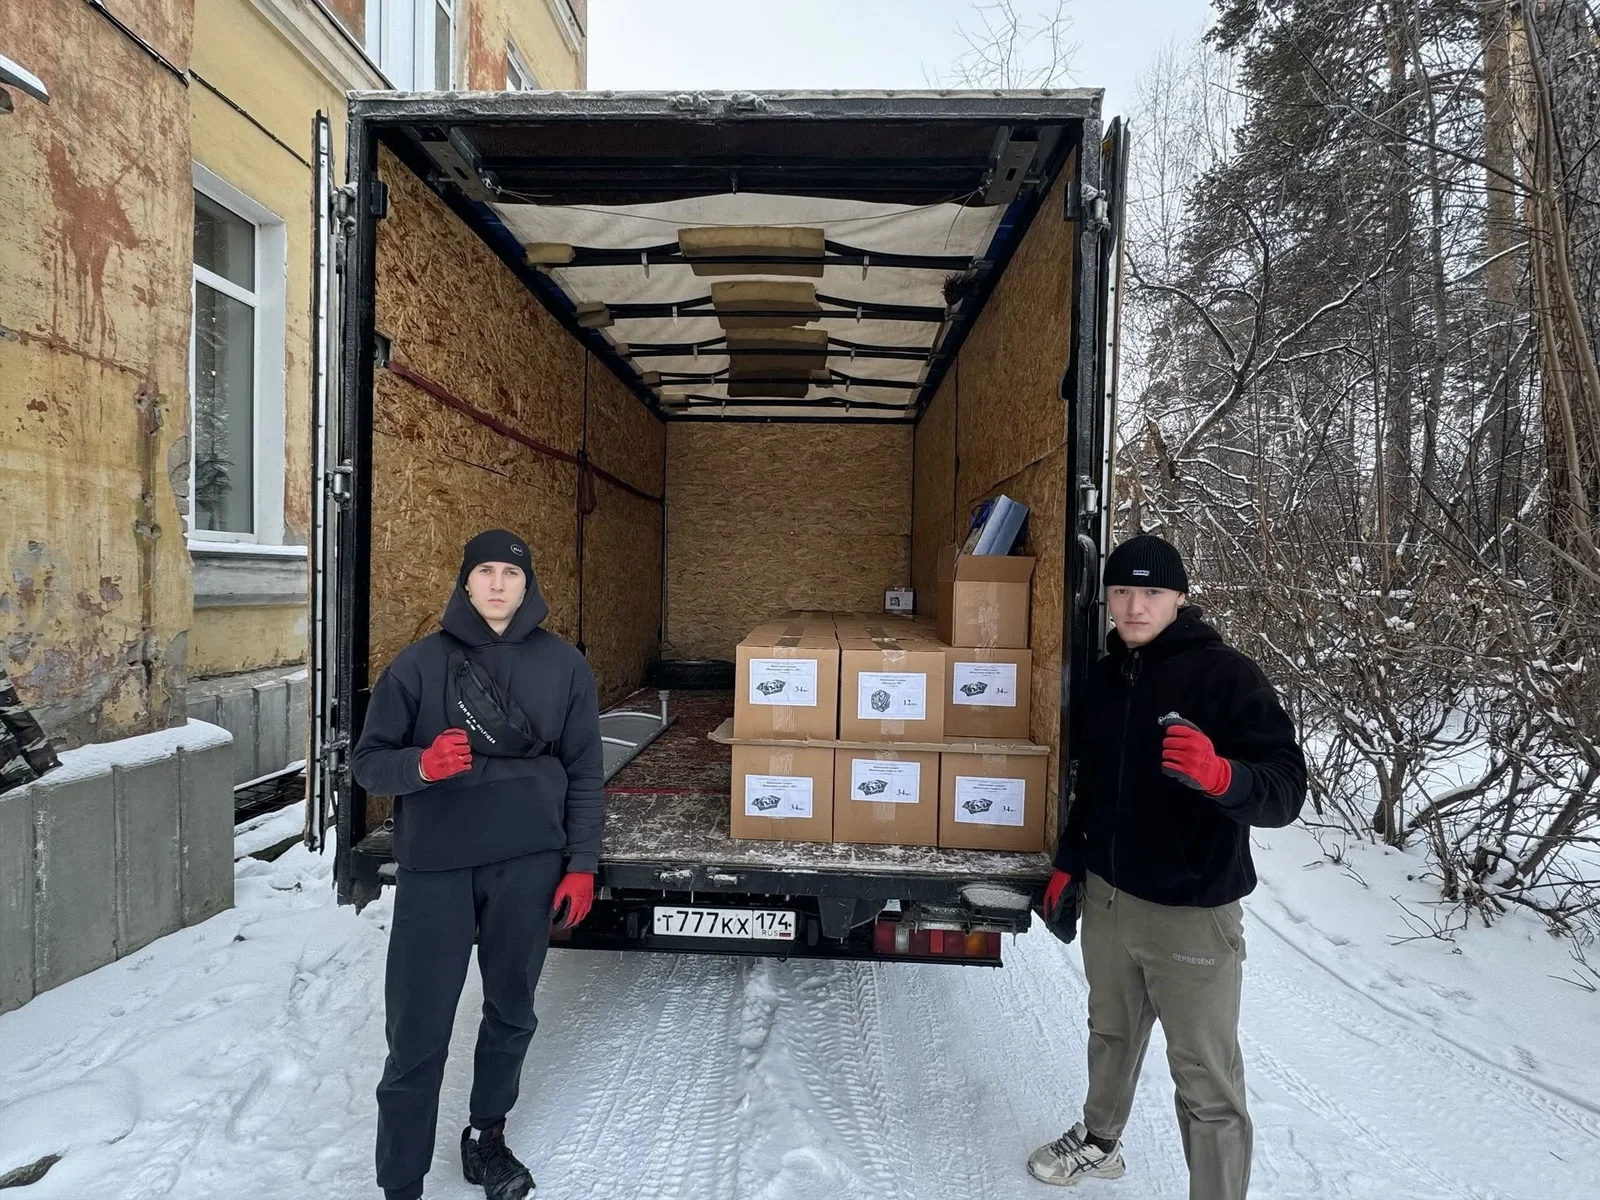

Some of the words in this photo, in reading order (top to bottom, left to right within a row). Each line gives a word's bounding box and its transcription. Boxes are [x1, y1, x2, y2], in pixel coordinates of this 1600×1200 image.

[755, 913, 788, 930] 174
[761, 929, 779, 937] RUS
[1172, 952, 1216, 966] REPRESENT
